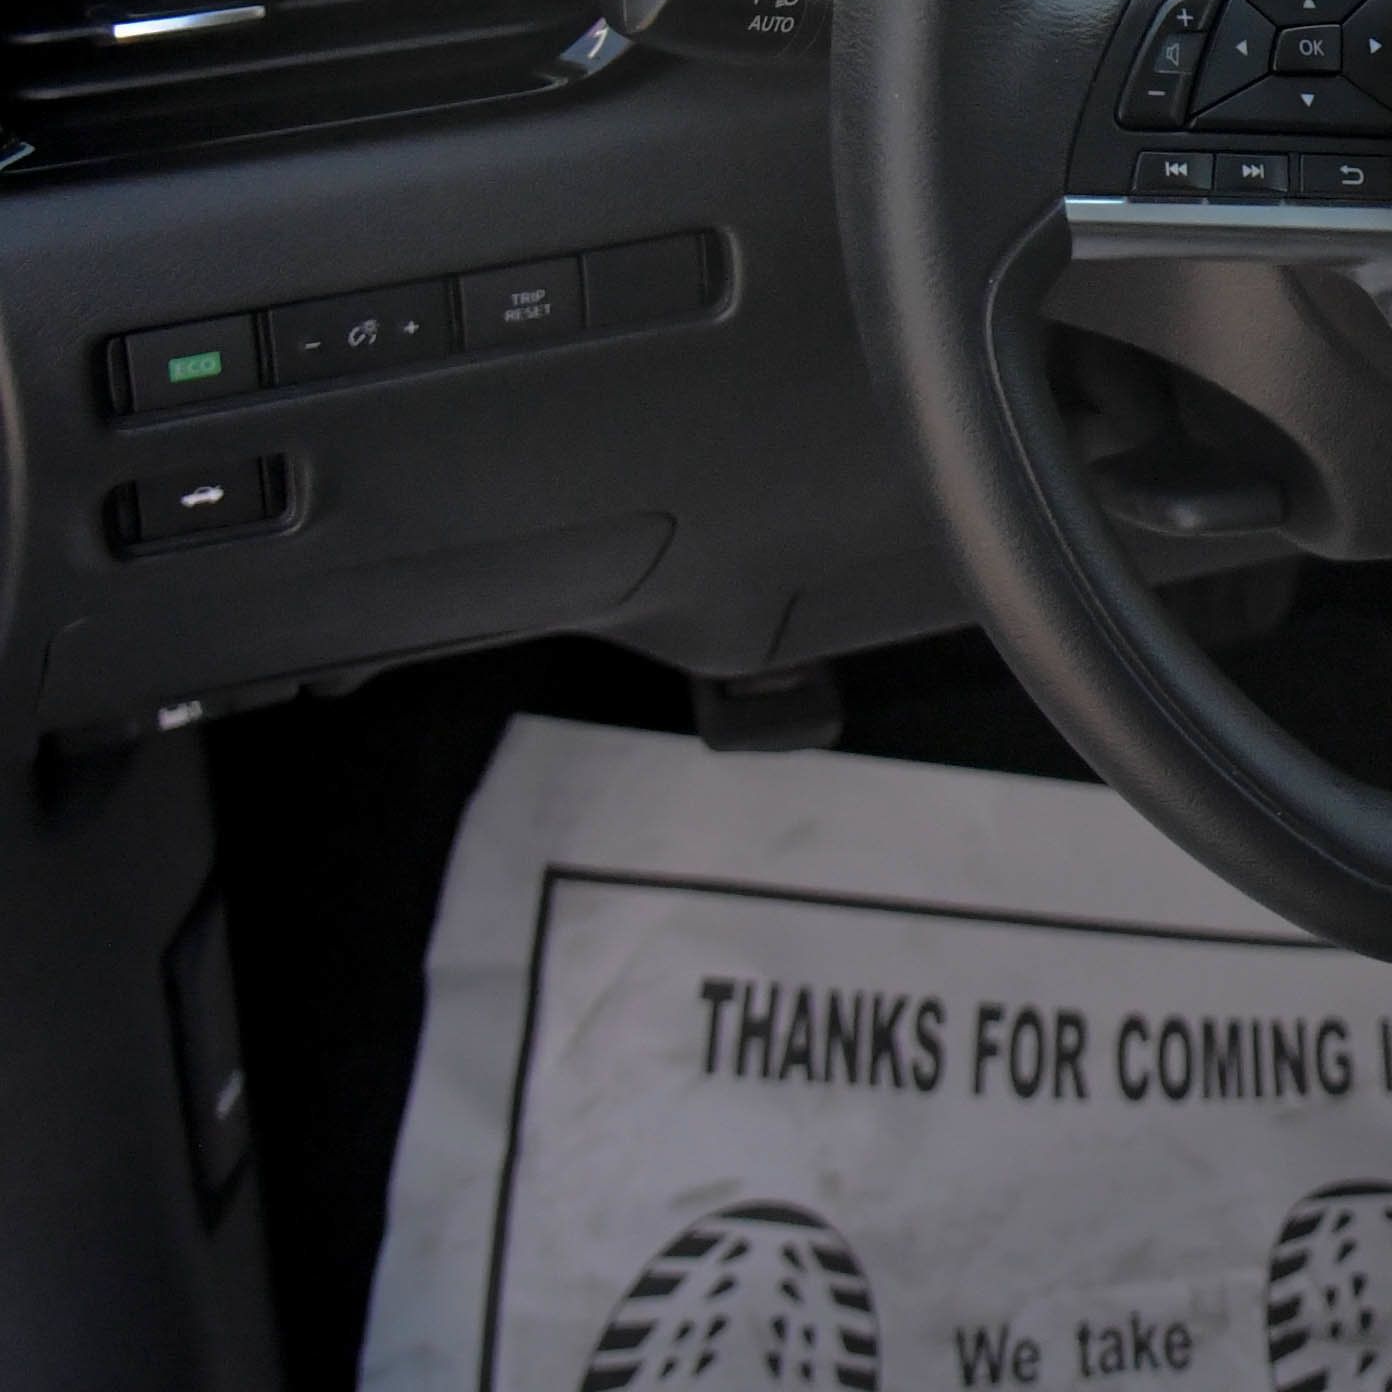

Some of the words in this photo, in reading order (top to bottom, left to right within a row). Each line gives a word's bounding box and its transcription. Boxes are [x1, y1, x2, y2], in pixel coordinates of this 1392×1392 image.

[748, 15, 795, 33] AUTO
[1299, 39, 1325, 56] OK
[699, 975, 946, 1095] THANKS
[972, 1005, 1088, 1101] FOR
[1115, 1013, 1354, 1105] COMING
[954, 1324, 1044, 1385] We
[1074, 1319, 1195, 1380] take
